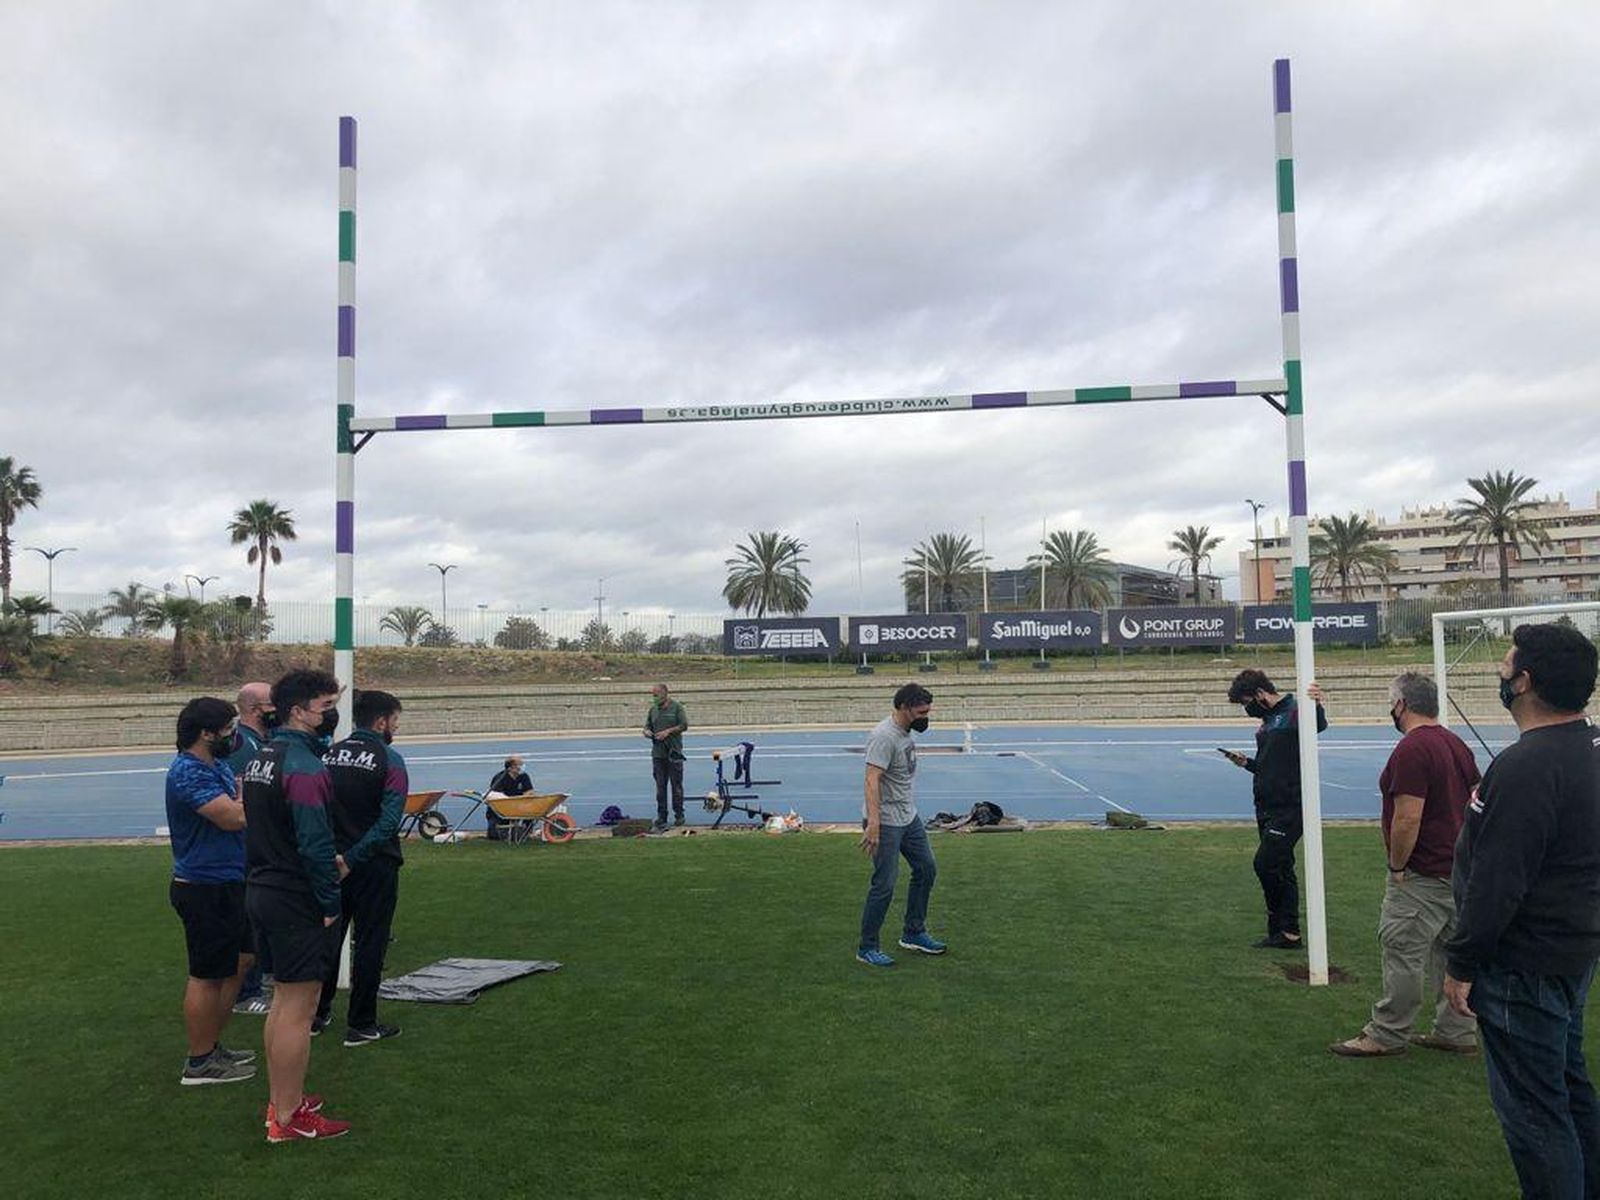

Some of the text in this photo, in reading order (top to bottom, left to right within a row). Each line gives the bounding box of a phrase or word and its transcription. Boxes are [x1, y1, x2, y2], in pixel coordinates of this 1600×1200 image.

[1143, 618, 1224, 631] PONT GRUP
[1255, 615, 1368, 630] POWRADE
[760, 628, 829, 648] TESESA
[881, 625, 956, 641] BESOCCER
